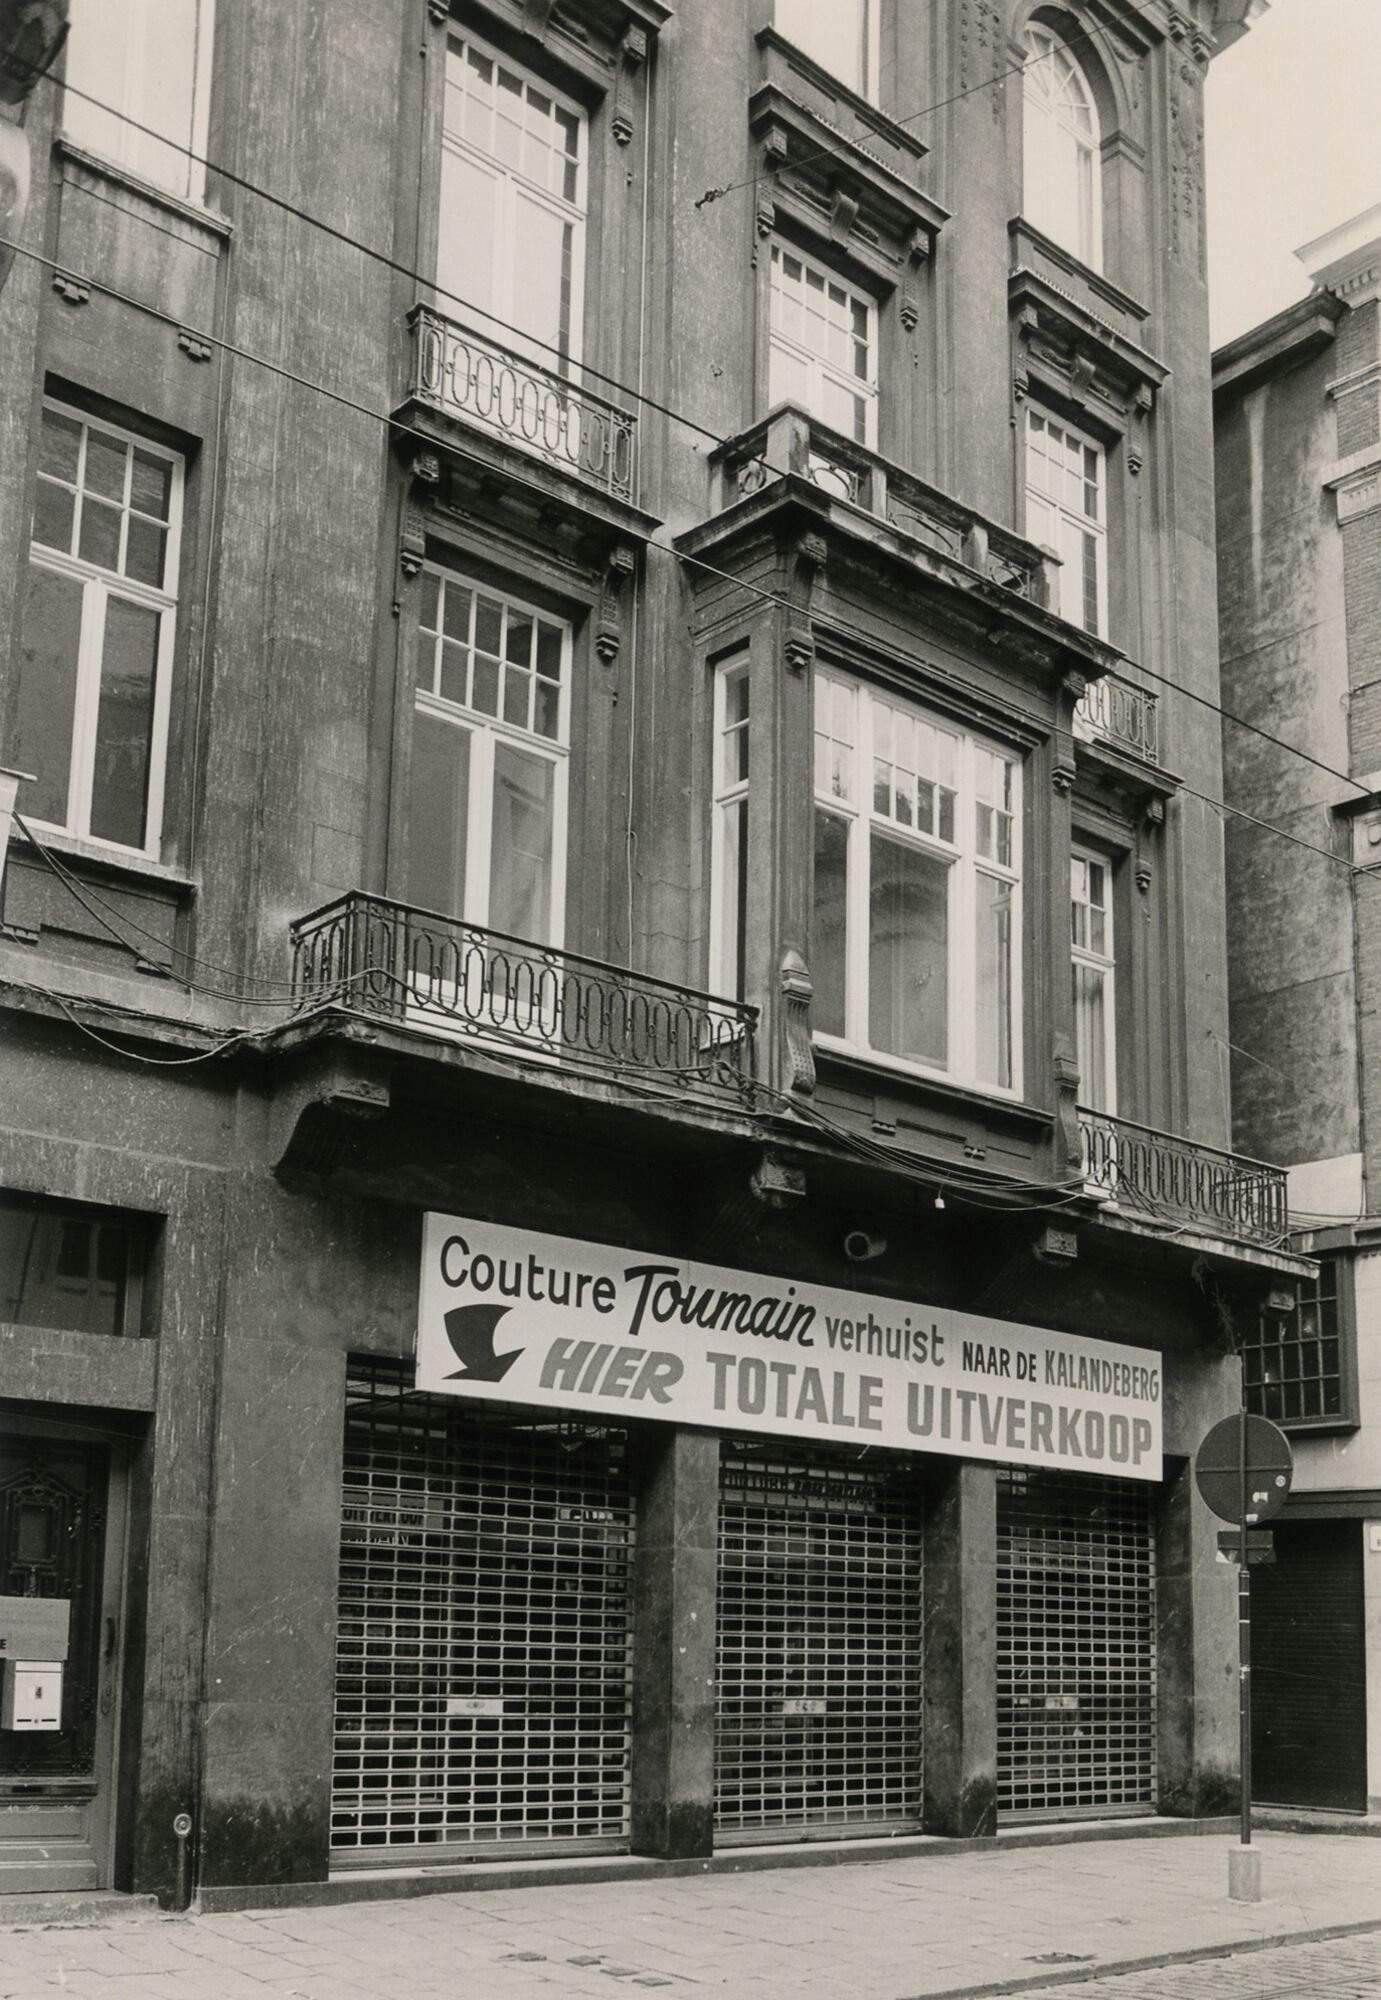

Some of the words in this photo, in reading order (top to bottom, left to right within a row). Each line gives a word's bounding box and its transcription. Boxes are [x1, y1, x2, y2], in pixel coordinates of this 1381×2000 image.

[440, 1235, 616, 1314] Couture
[623, 1264, 817, 1347] Toumain
[825, 1313, 945, 1367] verhuist
[962, 1341, 1011, 1378] NAAR
[1016, 1351, 1037, 1382] DE
[1045, 1349, 1160, 1402] KALANDEBERG
[538, 1337, 685, 1405] HIER
[705, 1351, 884, 1431] TOTALE
[906, 1381, 1153, 1466] UITVERKOOP
